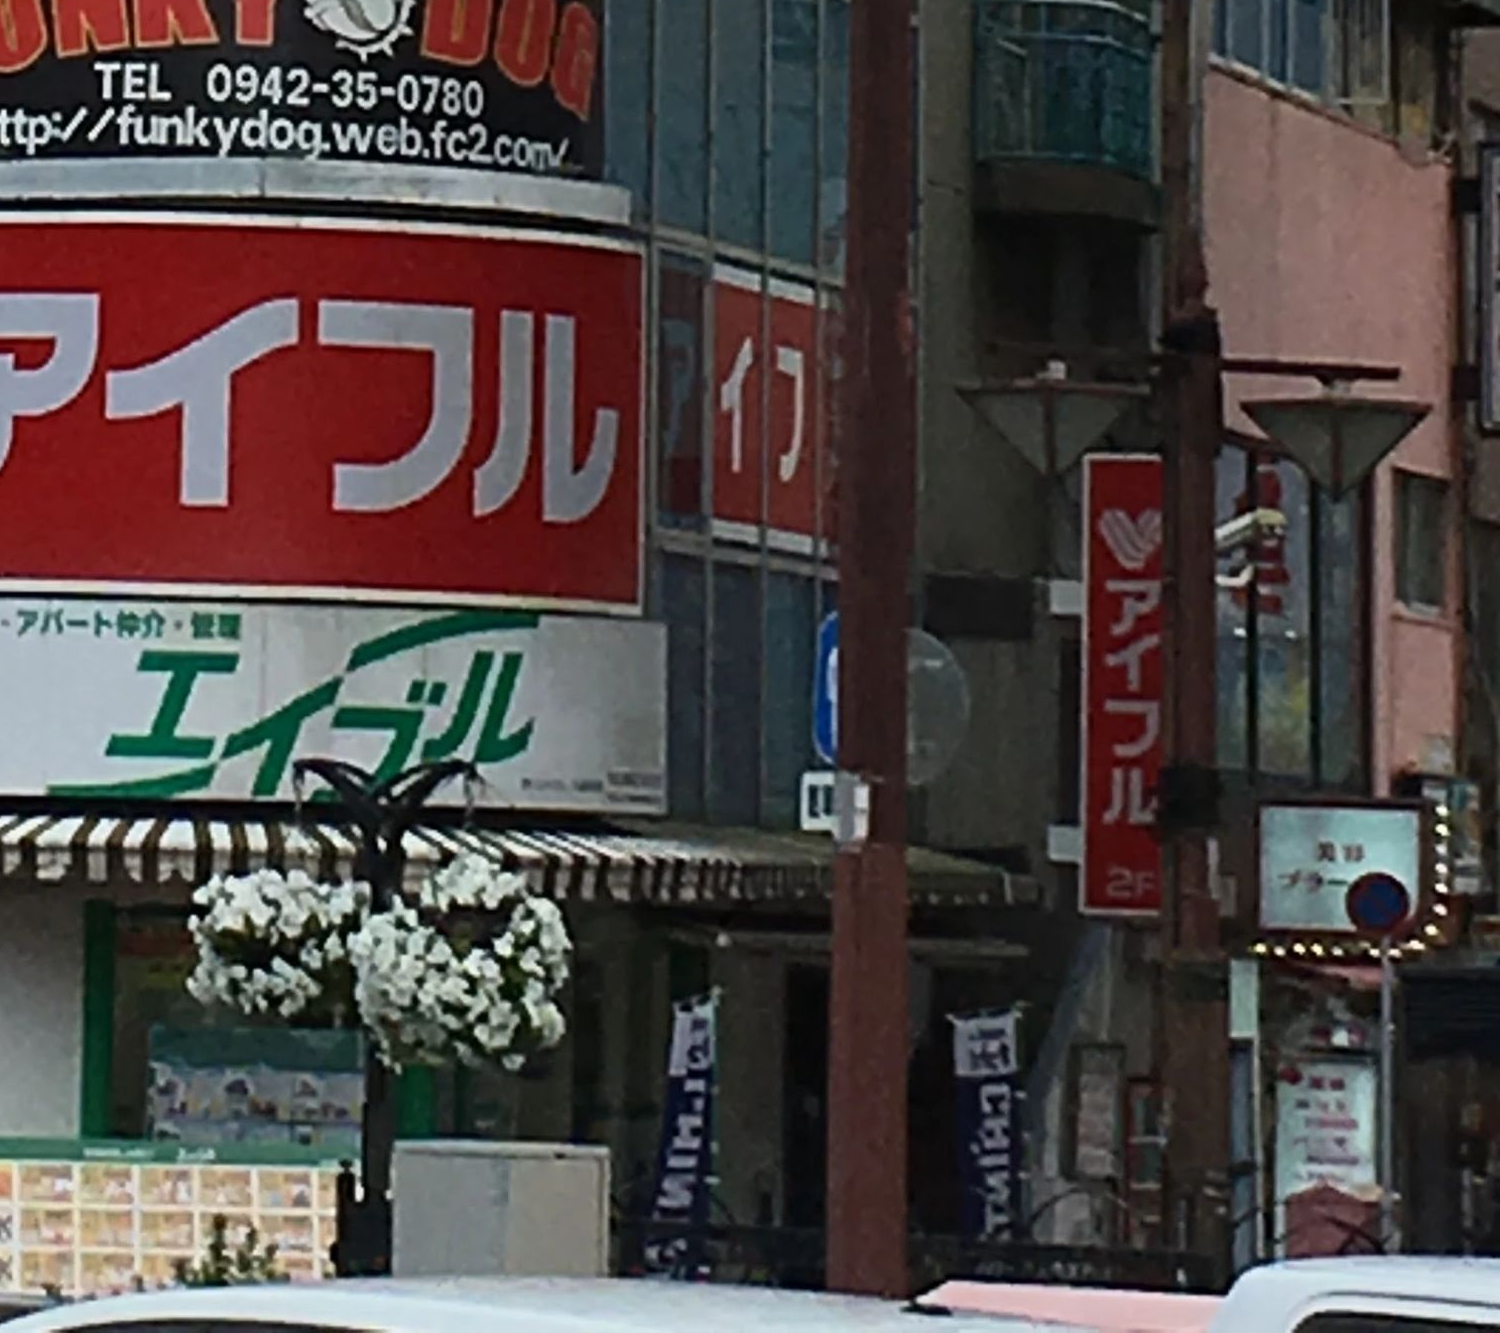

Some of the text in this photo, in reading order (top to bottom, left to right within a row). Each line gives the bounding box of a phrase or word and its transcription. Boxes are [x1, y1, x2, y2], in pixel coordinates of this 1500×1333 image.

[94, 62, 484, 117] TEL 0942-35-0780
[105, 648, 537, 806] エイブル
[1102, 578, 1161, 826] アイフル
[1105, 867, 1156, 899] 2F
